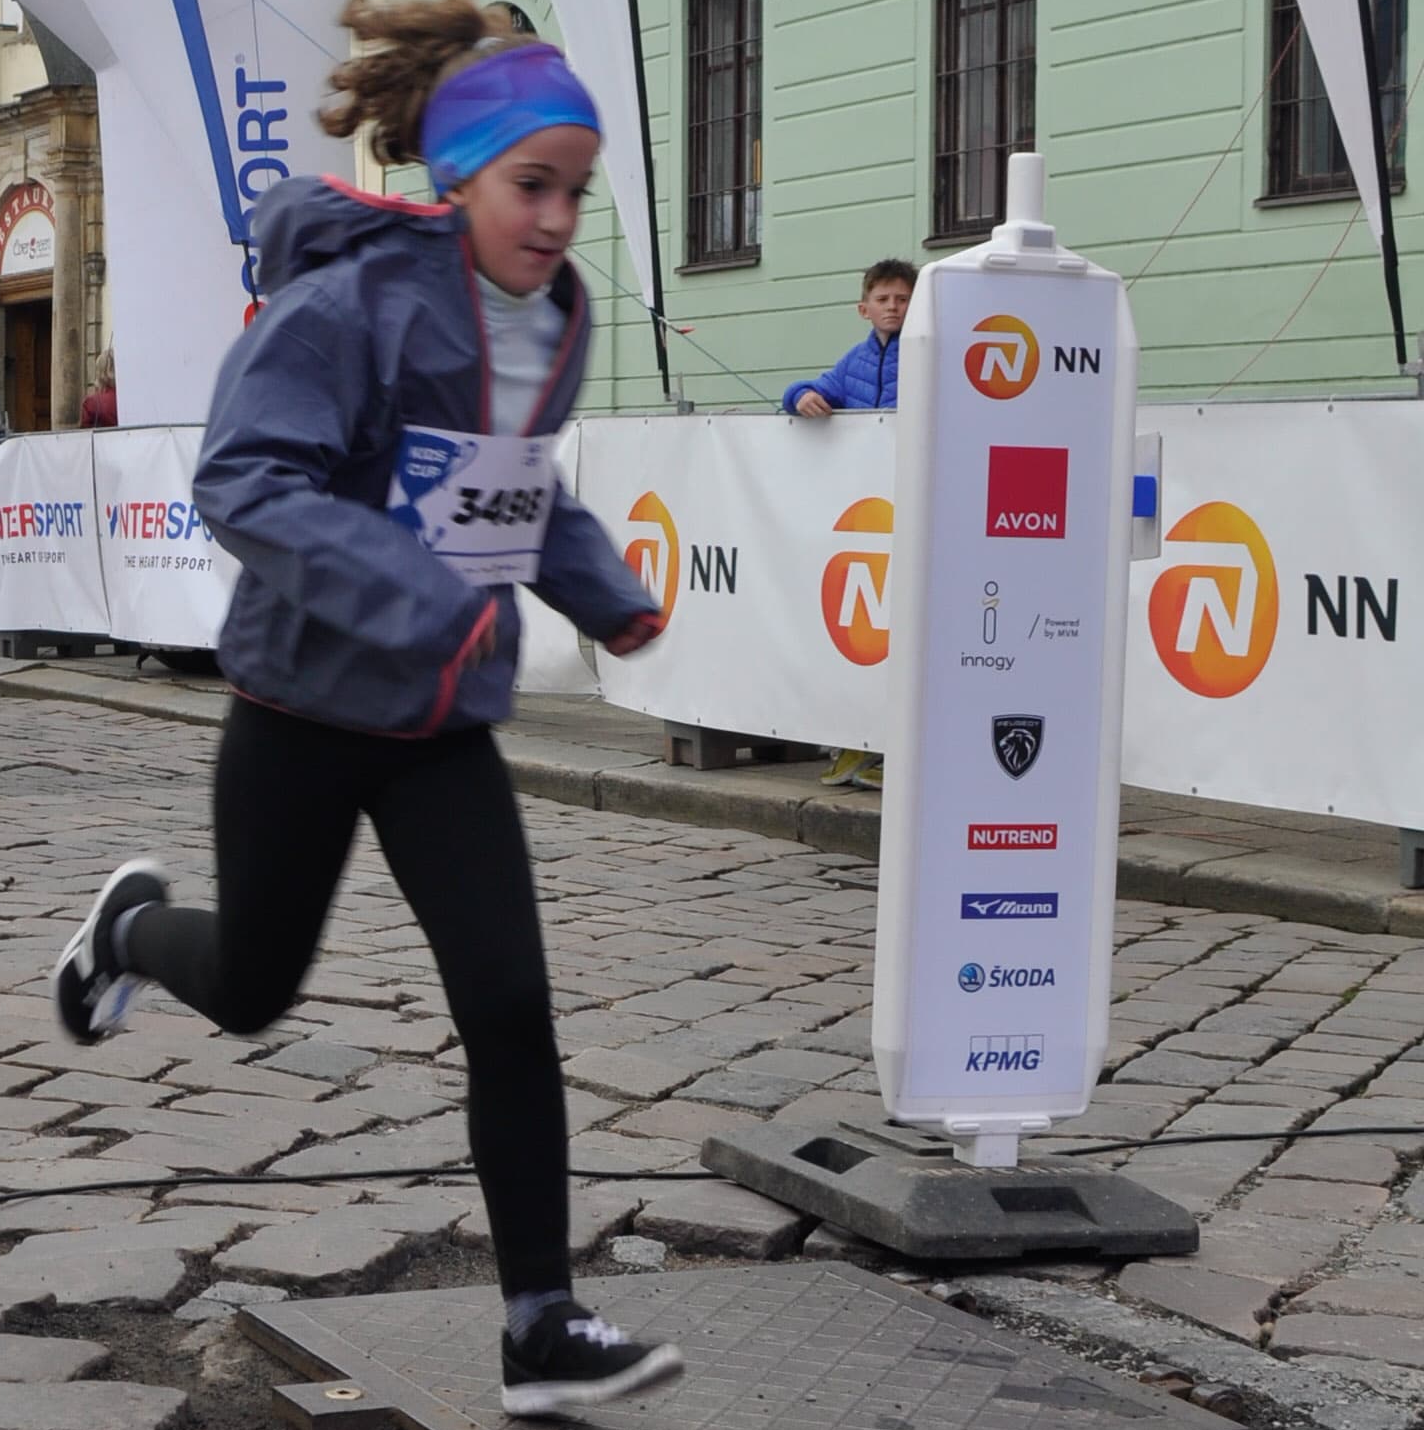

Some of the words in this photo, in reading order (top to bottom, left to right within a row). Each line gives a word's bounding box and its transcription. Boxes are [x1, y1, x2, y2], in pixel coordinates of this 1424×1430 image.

[1054, 346, 1100, 374] NN
[994, 512, 1057, 531] AVON
[174, 556, 213, 572] SPORT
[690, 544, 737, 594] NN
[1304, 573, 1398, 642] NN
[1044, 618, 1080, 627] Powered
[1044, 629, 1055, 640] by
[1057, 628, 1079, 637] MVM
[960, 651, 1015, 671] innogy
[973, 829, 1054, 844] NUTREND
[988, 965, 1056, 987] ŠKODA
[965, 1049, 1041, 1072] KPMG
